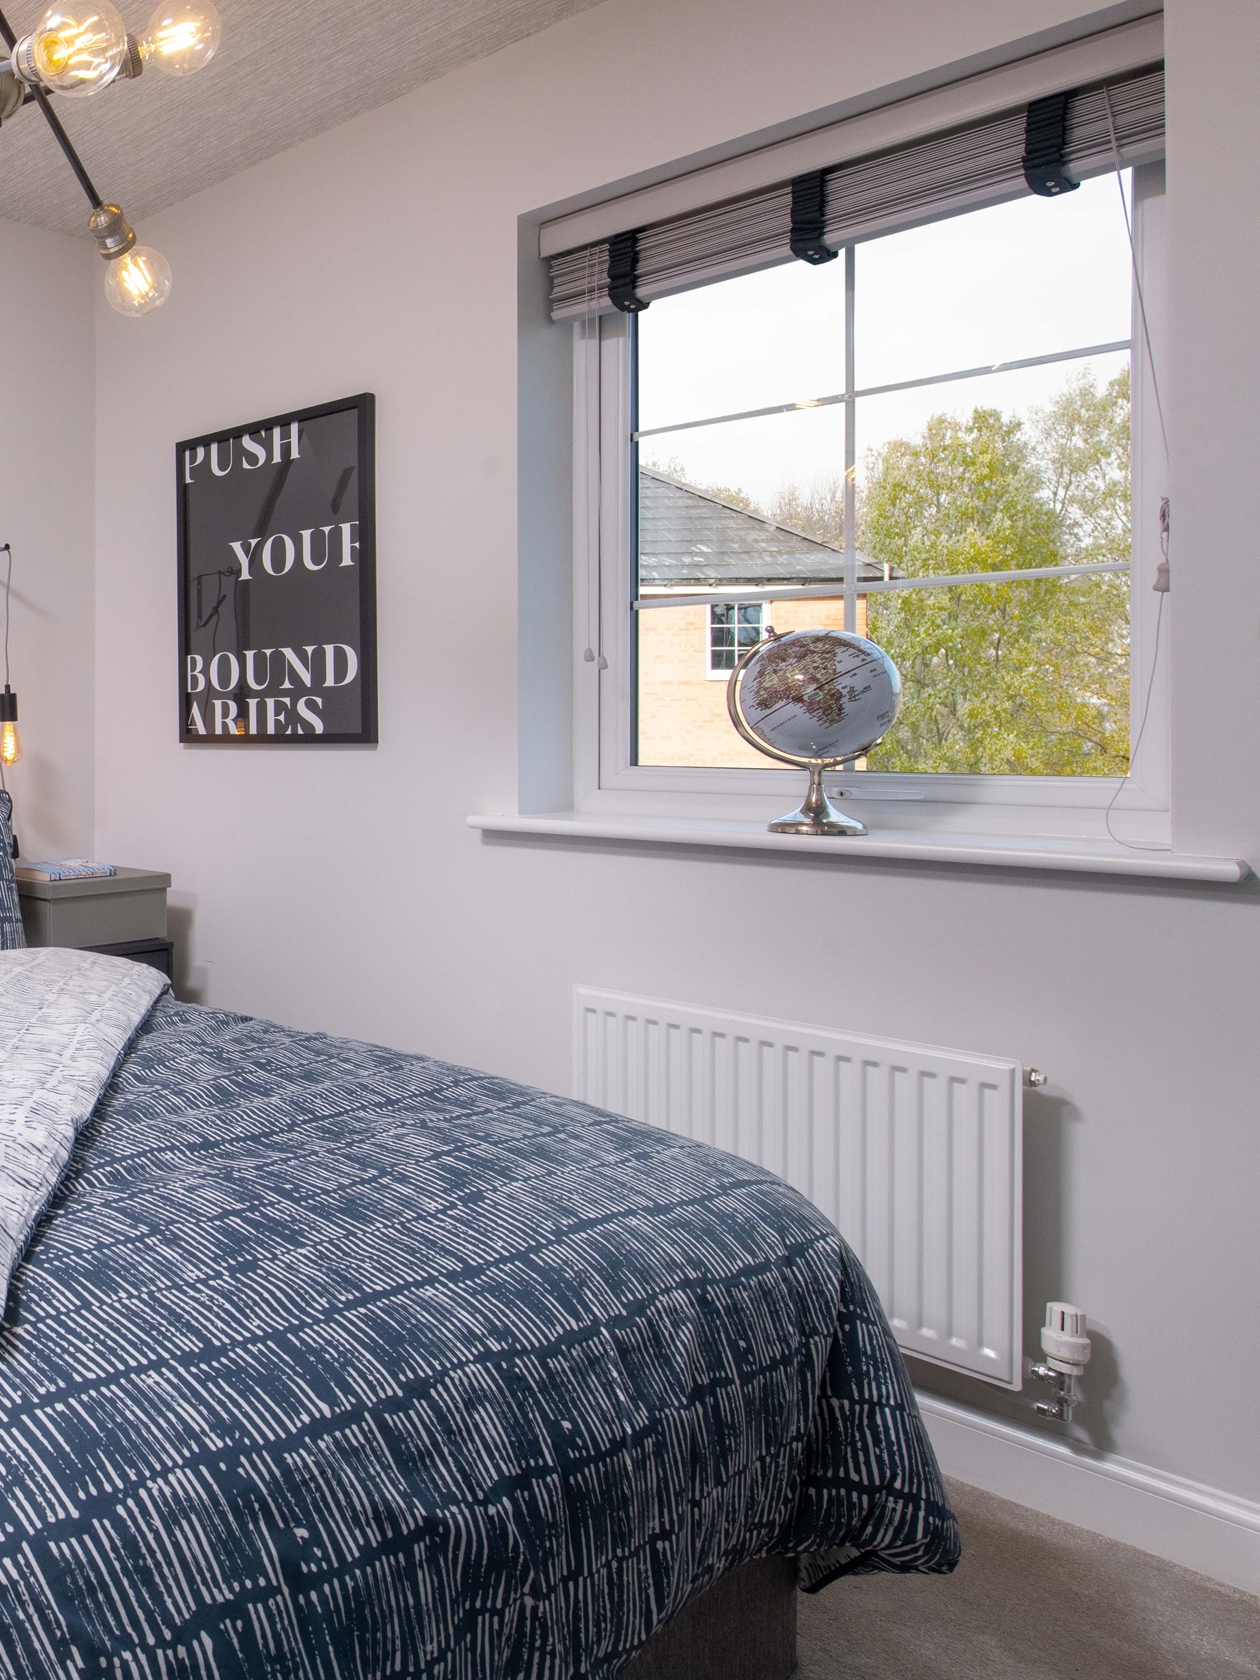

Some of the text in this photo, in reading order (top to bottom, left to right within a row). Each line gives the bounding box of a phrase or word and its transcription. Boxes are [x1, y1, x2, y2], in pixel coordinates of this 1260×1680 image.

[185, 421, 300, 484] PUSH
[187, 643, 358, 693] BOUND
[188, 695, 324, 735] ARIES
